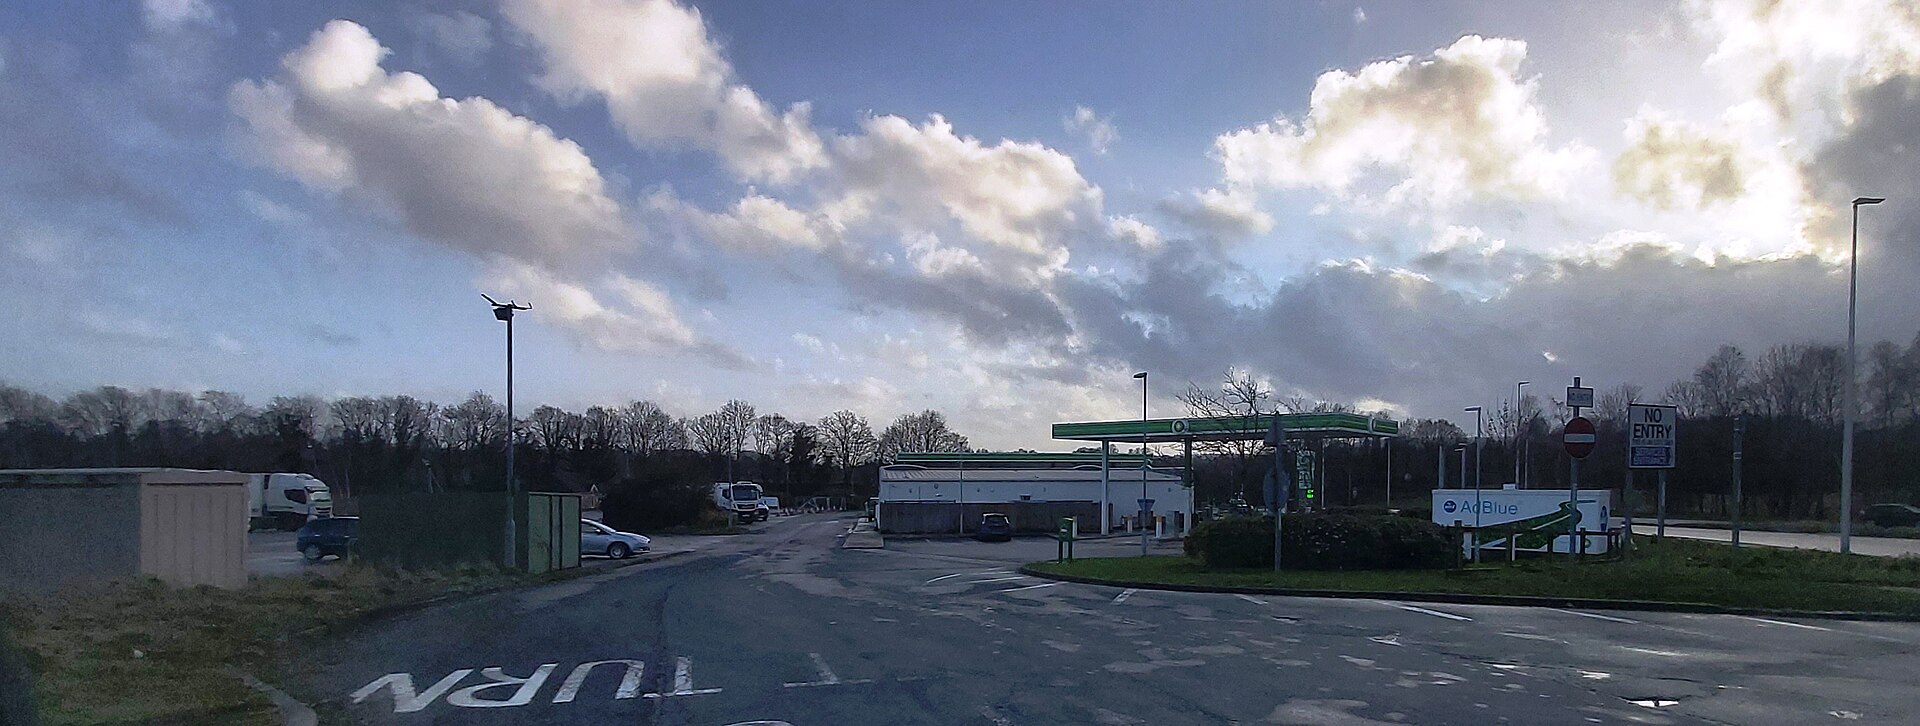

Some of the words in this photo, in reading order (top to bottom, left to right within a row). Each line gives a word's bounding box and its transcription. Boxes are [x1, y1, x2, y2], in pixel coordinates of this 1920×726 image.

[1645, 408, 1662, 423] NO
[1633, 423, 1672, 439] ENTRY
[1460, 500, 1518, 515] AdBlue
[350, 656, 723, 713] TURN
